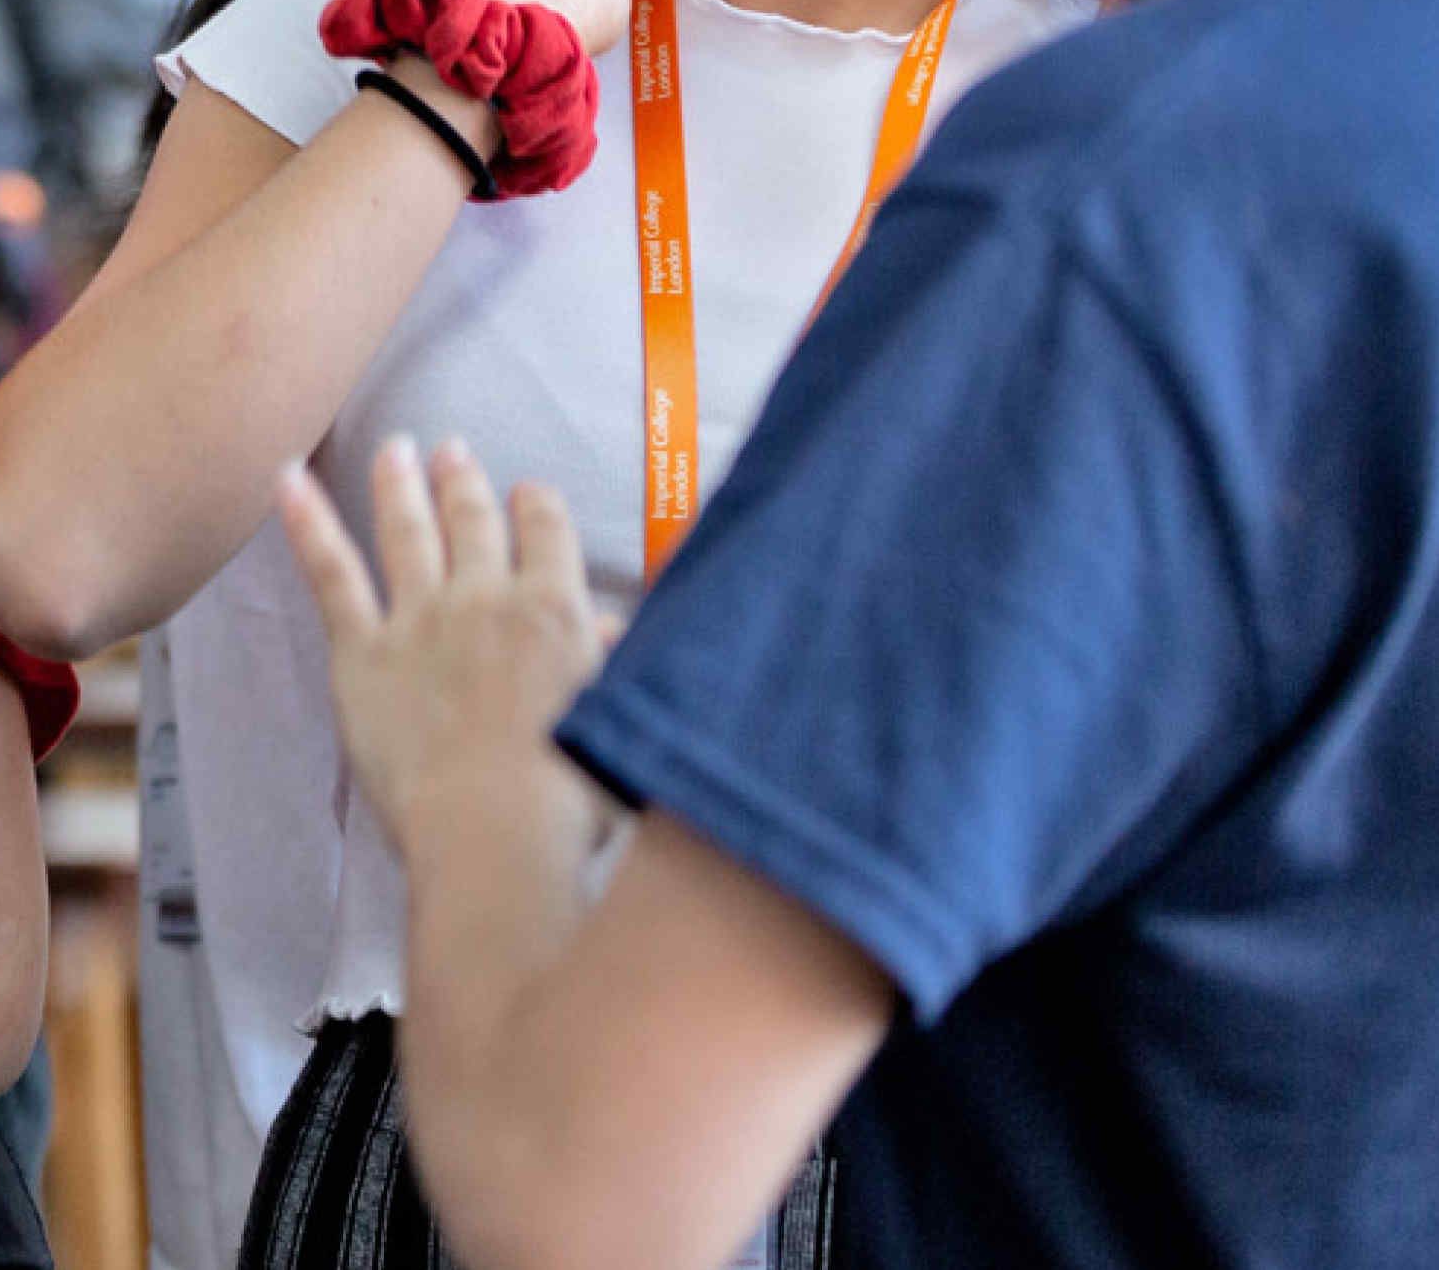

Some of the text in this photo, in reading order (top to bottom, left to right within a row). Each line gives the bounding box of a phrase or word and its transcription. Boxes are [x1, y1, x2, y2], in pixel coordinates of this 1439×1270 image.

[656, 43, 672, 98] London
[643, 189, 667, 294] Imperial College
[665, 239, 683, 294] London
[651, 388, 674, 518] Imperial College
[672, 451, 690, 518] London
